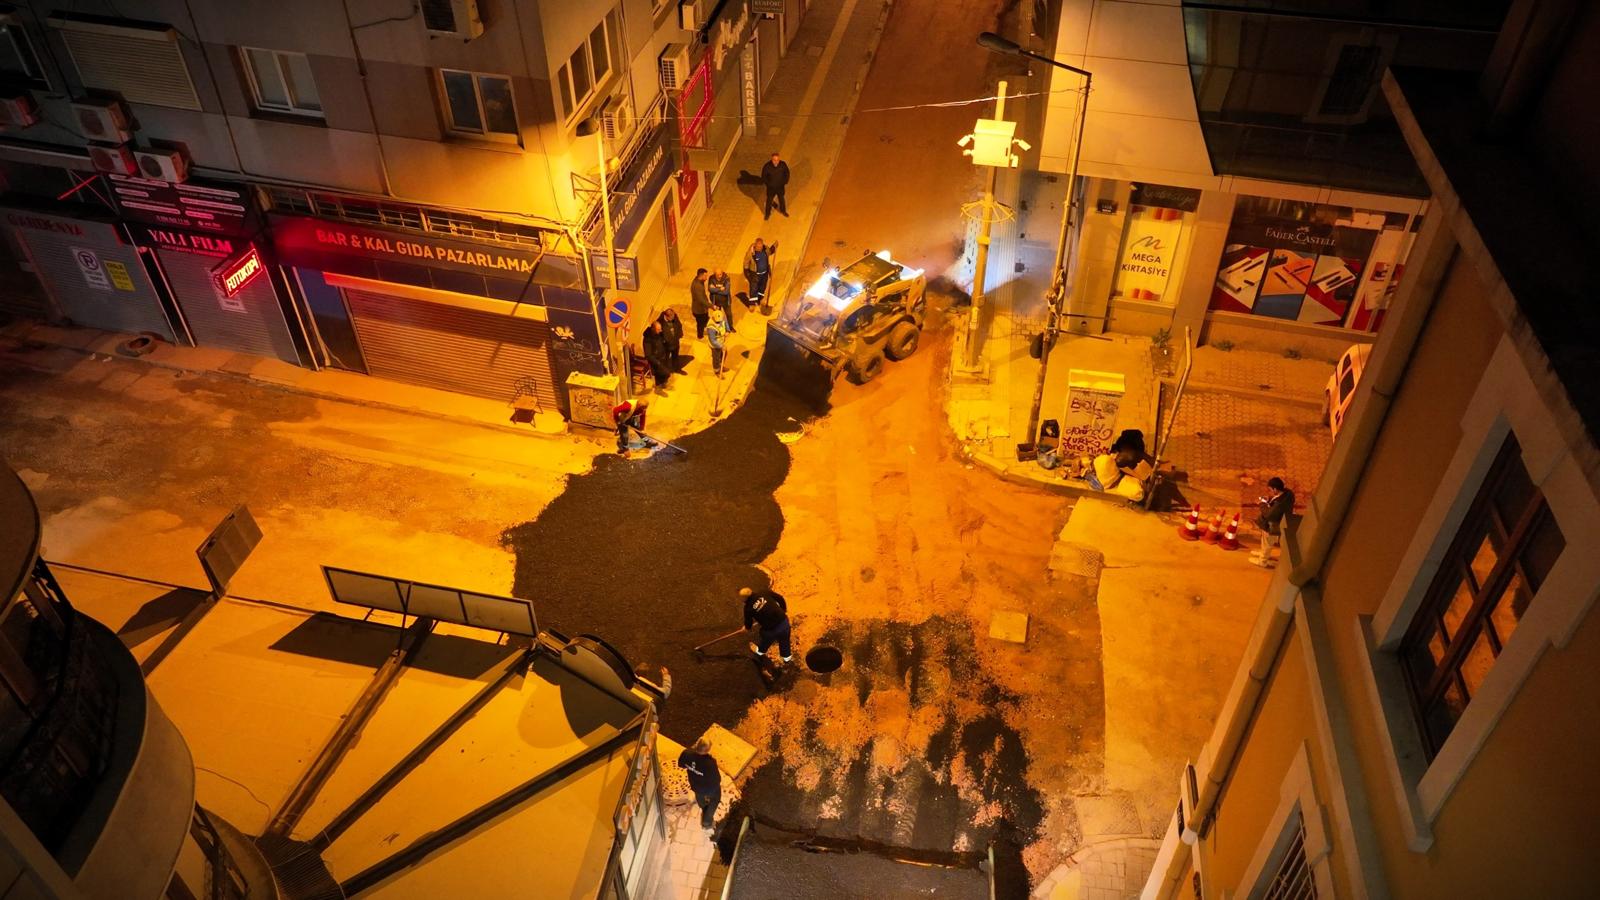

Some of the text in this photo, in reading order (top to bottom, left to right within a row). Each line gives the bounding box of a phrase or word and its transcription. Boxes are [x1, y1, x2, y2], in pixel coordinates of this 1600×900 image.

[316, 230, 531, 273] BAR & KAL GIDA PAZARLAMA
[1131, 252, 1161, 264] MEGA
